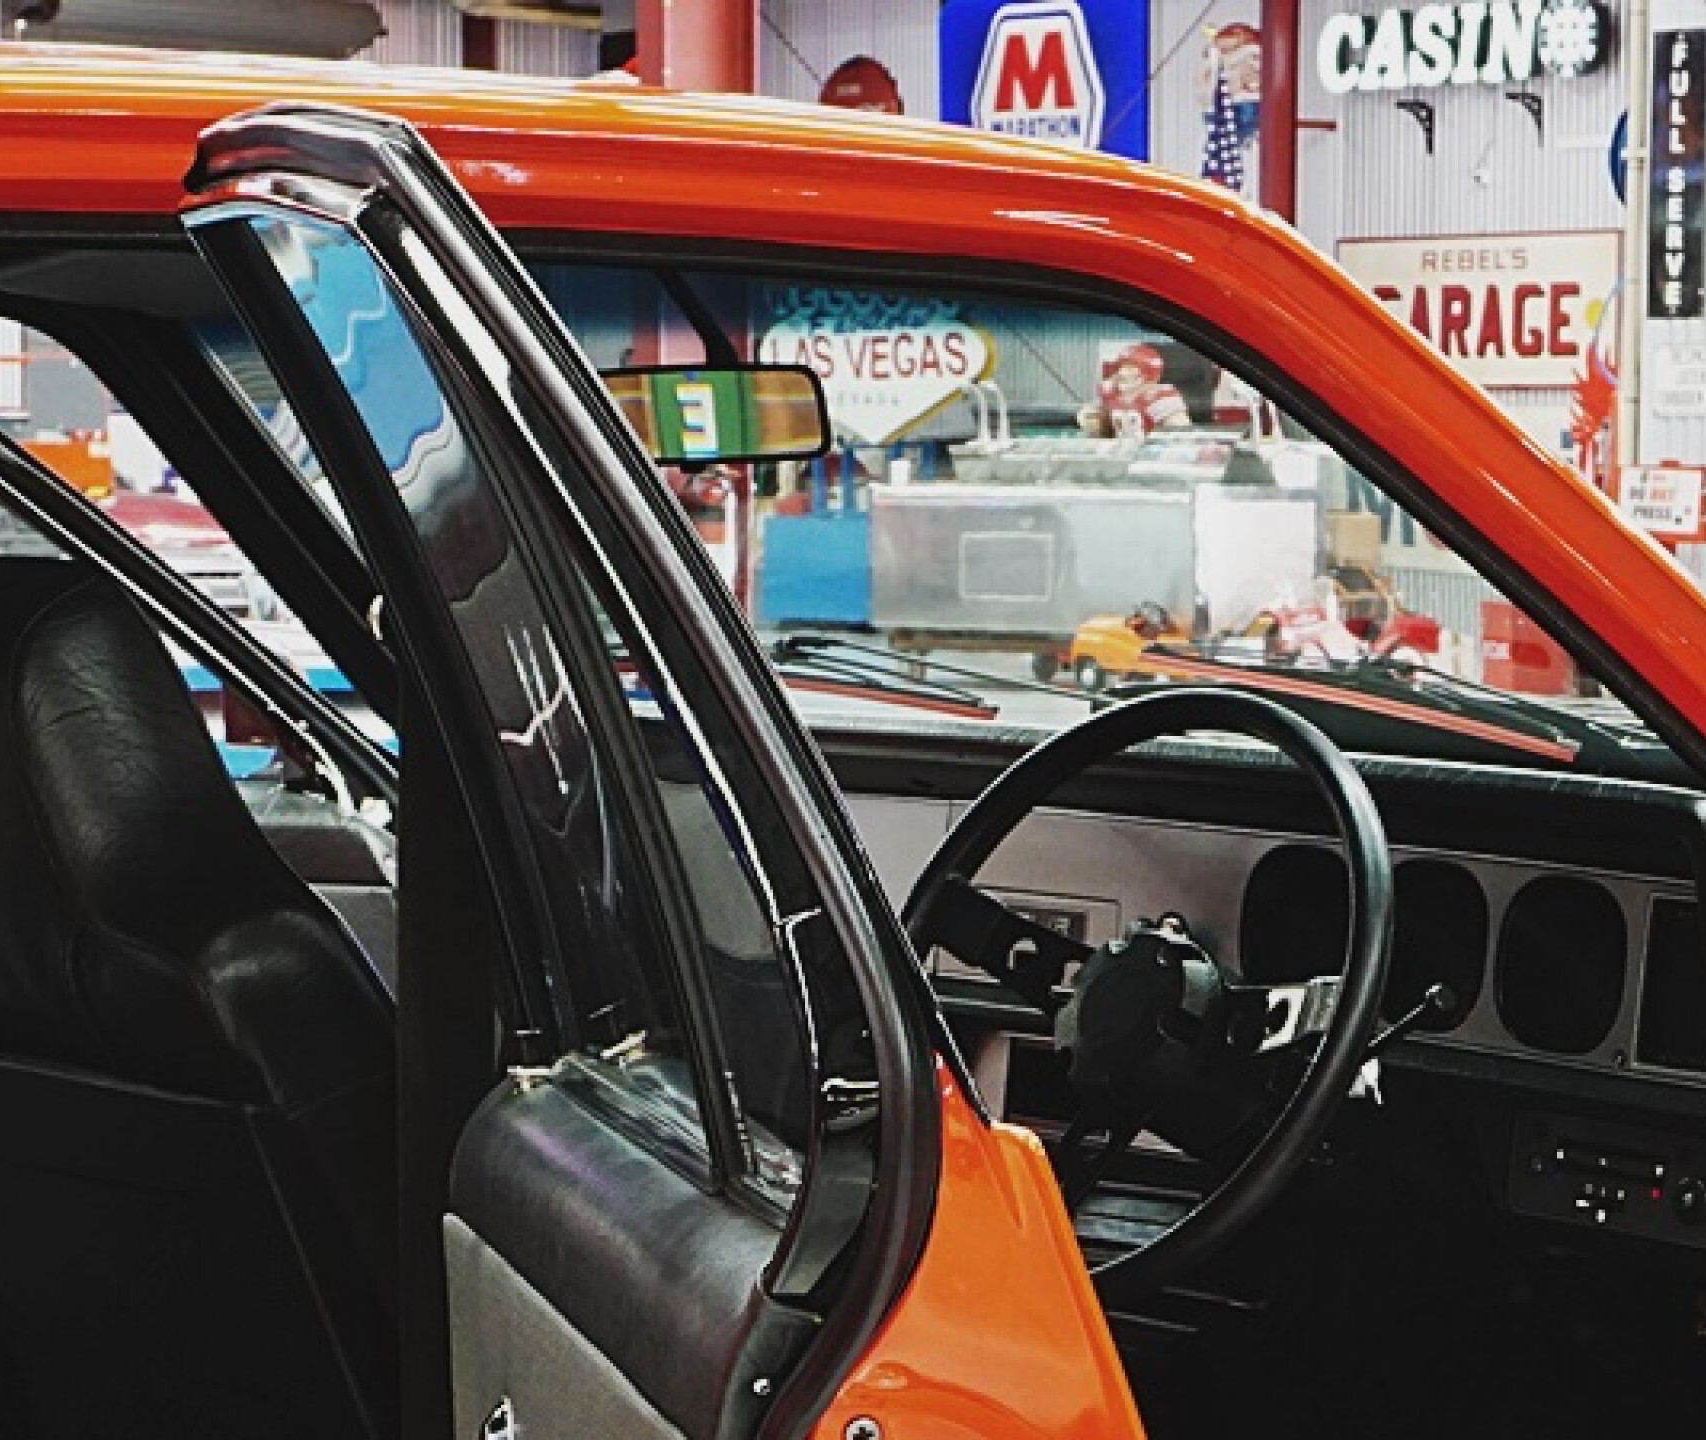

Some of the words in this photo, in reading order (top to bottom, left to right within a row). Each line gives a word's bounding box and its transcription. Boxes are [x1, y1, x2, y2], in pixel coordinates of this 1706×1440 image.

[994, 31, 1077, 112] M
[1421, 248, 1529, 273] REBEL'S
[1371, 281, 1581, 358] ARAGE
[844, 332, 970, 379] VEGAS
